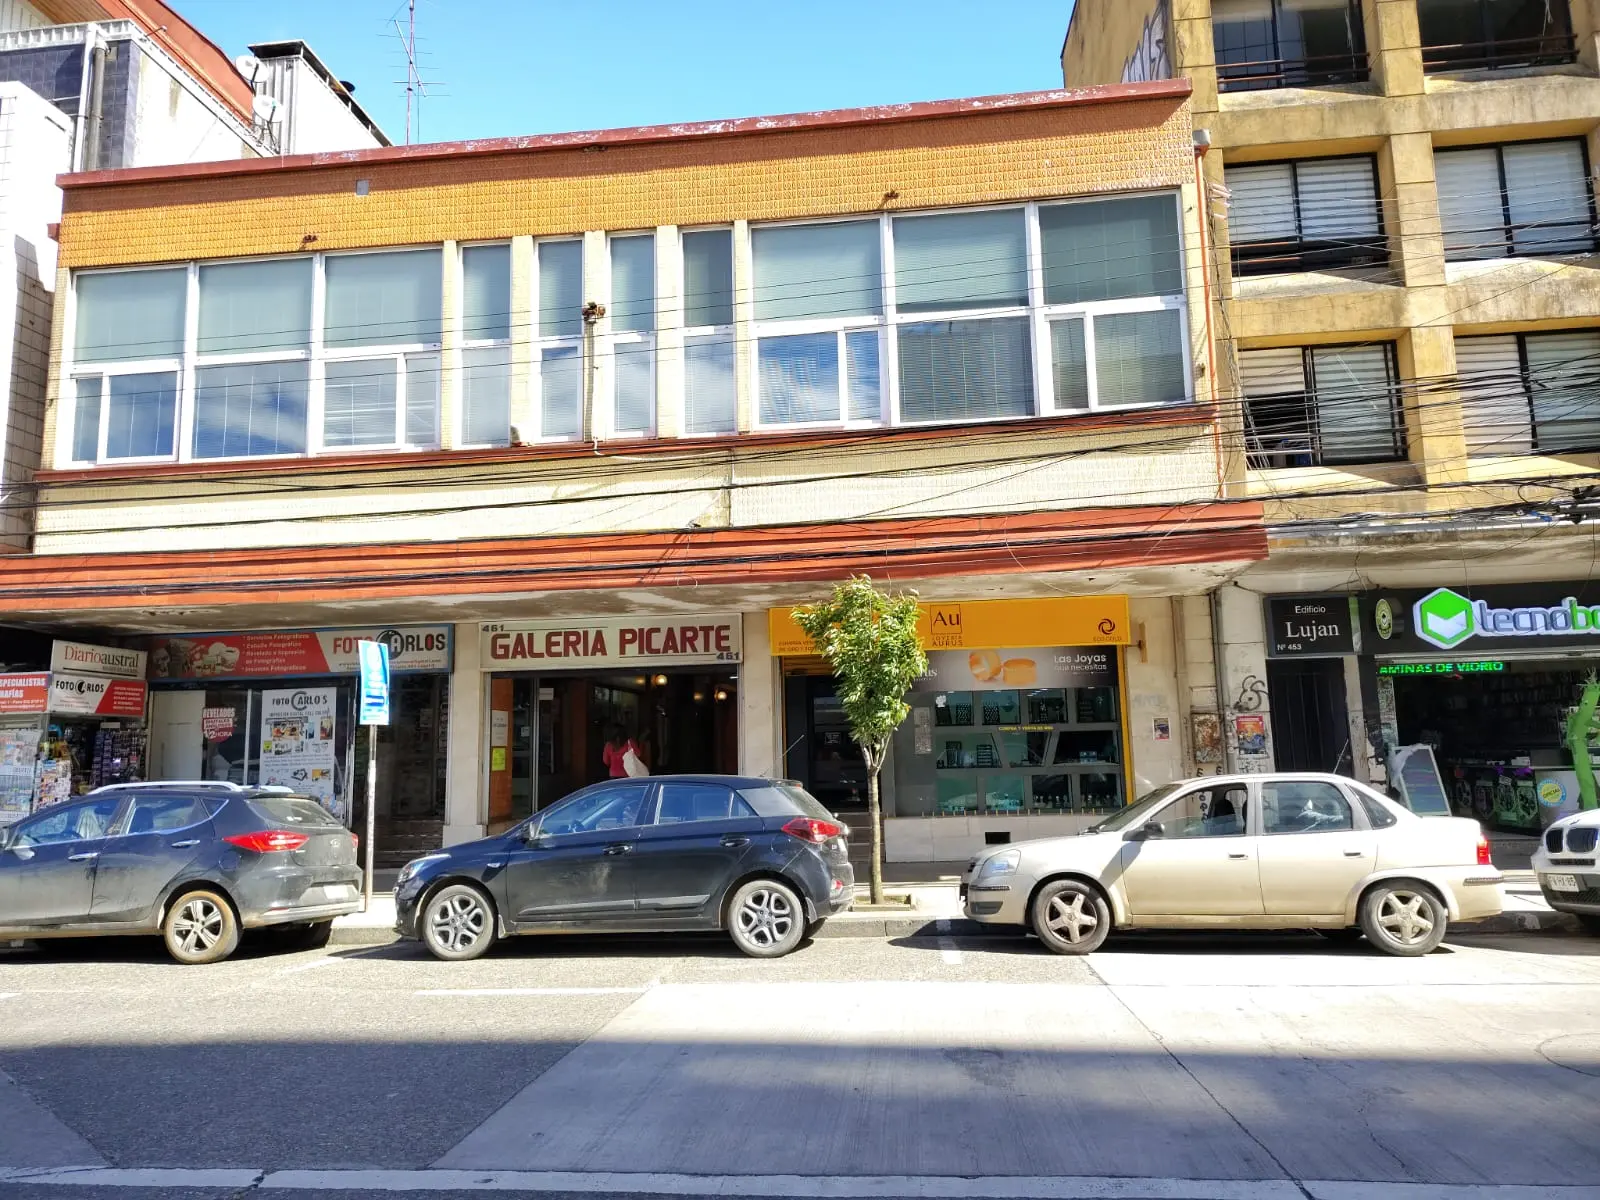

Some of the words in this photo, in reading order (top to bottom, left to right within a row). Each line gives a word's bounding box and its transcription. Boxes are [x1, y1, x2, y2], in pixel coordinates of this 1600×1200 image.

[1295, 605, 1326, 614] Edificio
[933, 611, 960, 626] Au
[1285, 620, 1340, 641] Lujan
[491, 630, 608, 660] GALERIA
[619, 625, 731, 655] PICARTE
[64, 645, 139, 668] Diarioaustral
[1054, 655, 1072, 663] Las
[1075, 654, 1107, 664] Joyas
[1435, 663, 1453, 672] DE
[55, 680, 75, 691] FOTO
[272, 697, 290, 706] FOTO
